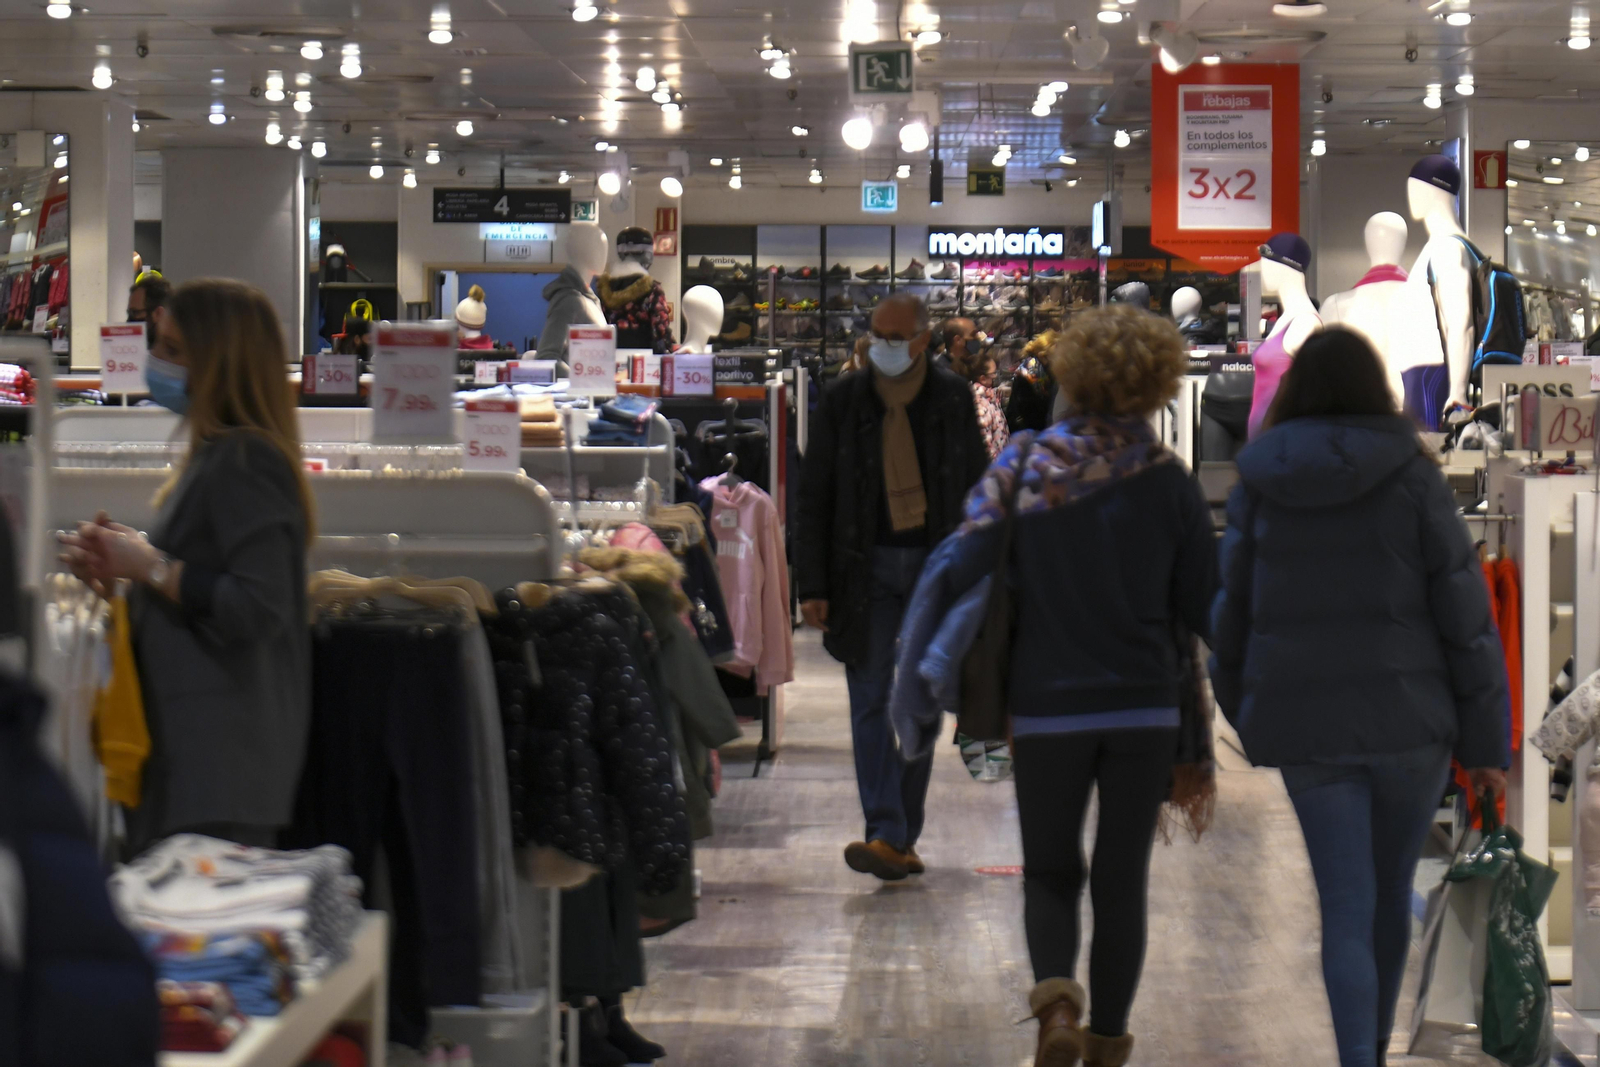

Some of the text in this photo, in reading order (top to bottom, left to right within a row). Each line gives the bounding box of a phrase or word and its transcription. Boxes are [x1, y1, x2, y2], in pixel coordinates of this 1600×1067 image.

[1203, 95, 1251, 108] rebajas
[1187, 130, 1253, 140] En todos los
[1187, 140, 1268, 151] complementos
[1188, 167, 1257, 200] 3x2
[493, 195, 510, 216] 4
[929, 227, 1063, 255] montaña
[677, 371, 711, 384] -30%
